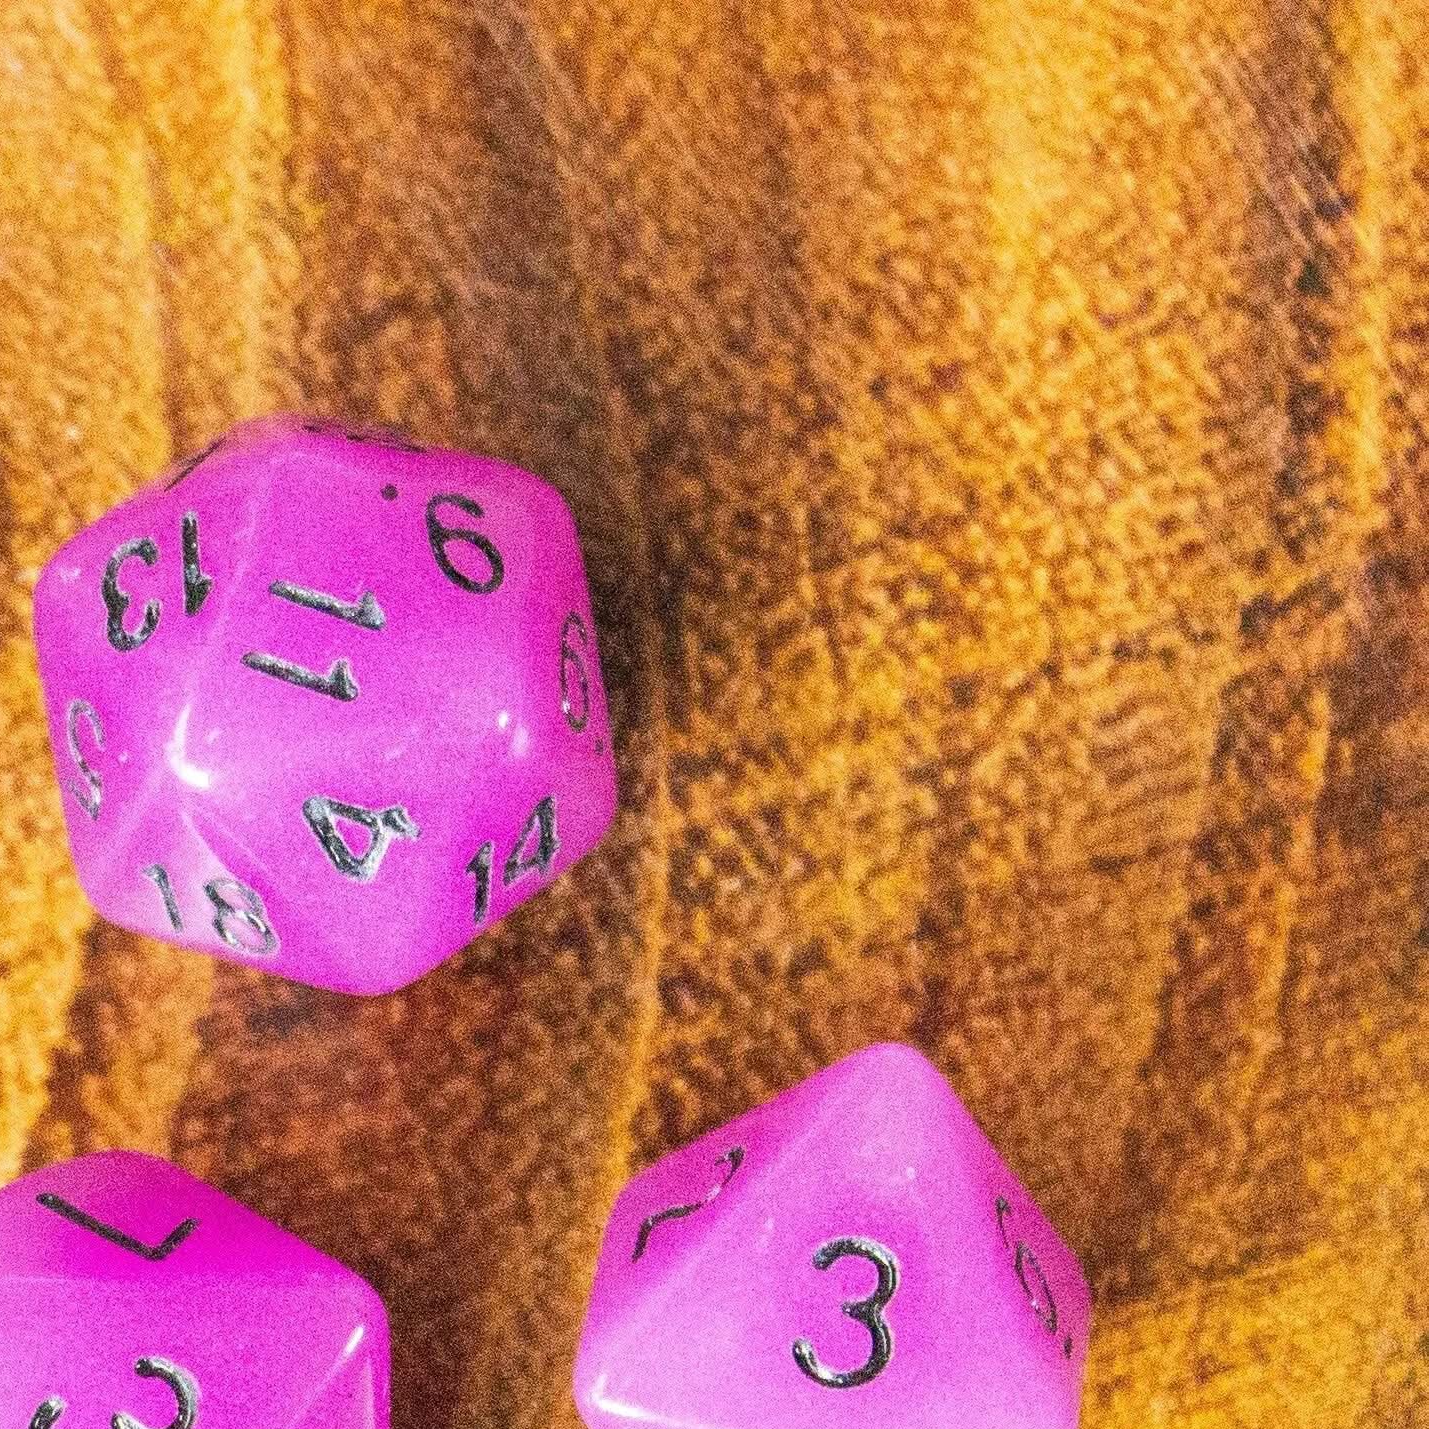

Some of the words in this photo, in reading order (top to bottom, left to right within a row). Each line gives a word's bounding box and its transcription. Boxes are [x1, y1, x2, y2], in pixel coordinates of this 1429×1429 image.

[101, 510, 212, 652] 13
[241, 579, 386, 701] 11
[302, 795, 422, 883] 4
[466, 795, 561, 924] 14
[143, 862, 280, 957] 18
[35, 1192, 201, 1262] 7
[791, 1236, 901, 1389] 3
